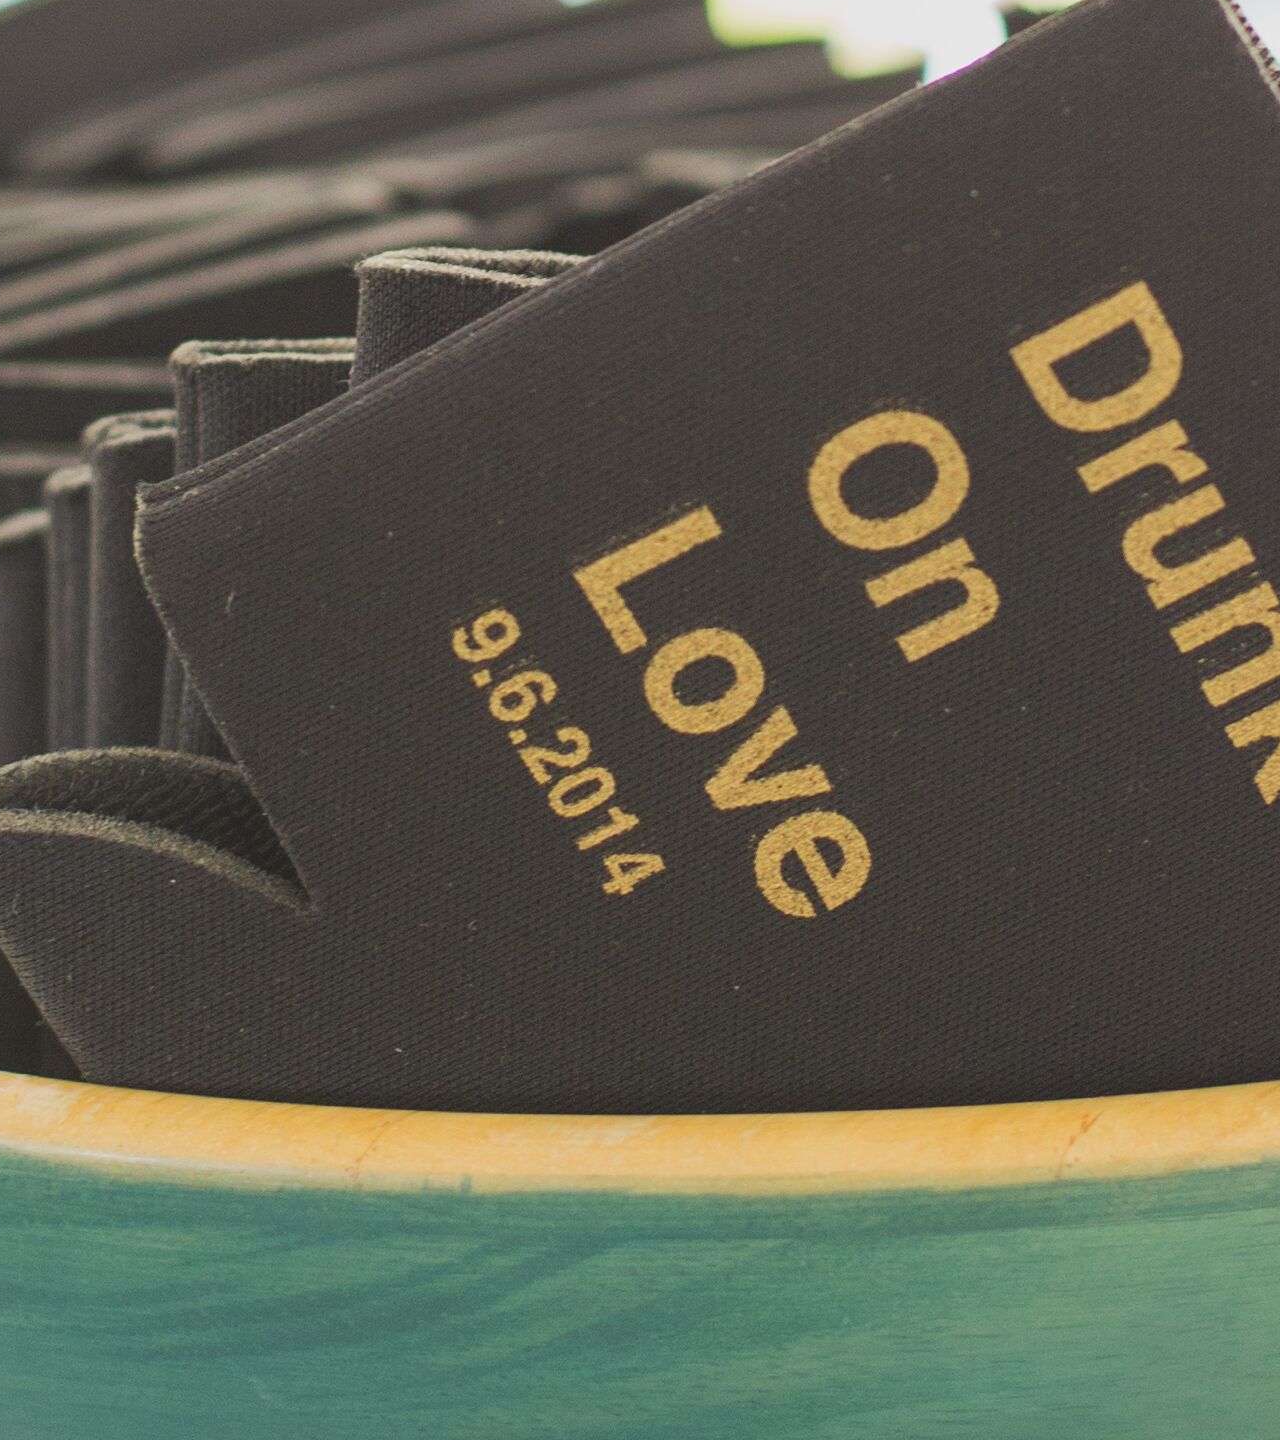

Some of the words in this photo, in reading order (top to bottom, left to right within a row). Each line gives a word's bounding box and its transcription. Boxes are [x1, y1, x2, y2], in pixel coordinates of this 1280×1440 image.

[807, 409, 1002, 664] On
[451, 607, 666, 897] 9.6.2014
[574, 506, 873, 920] Love
